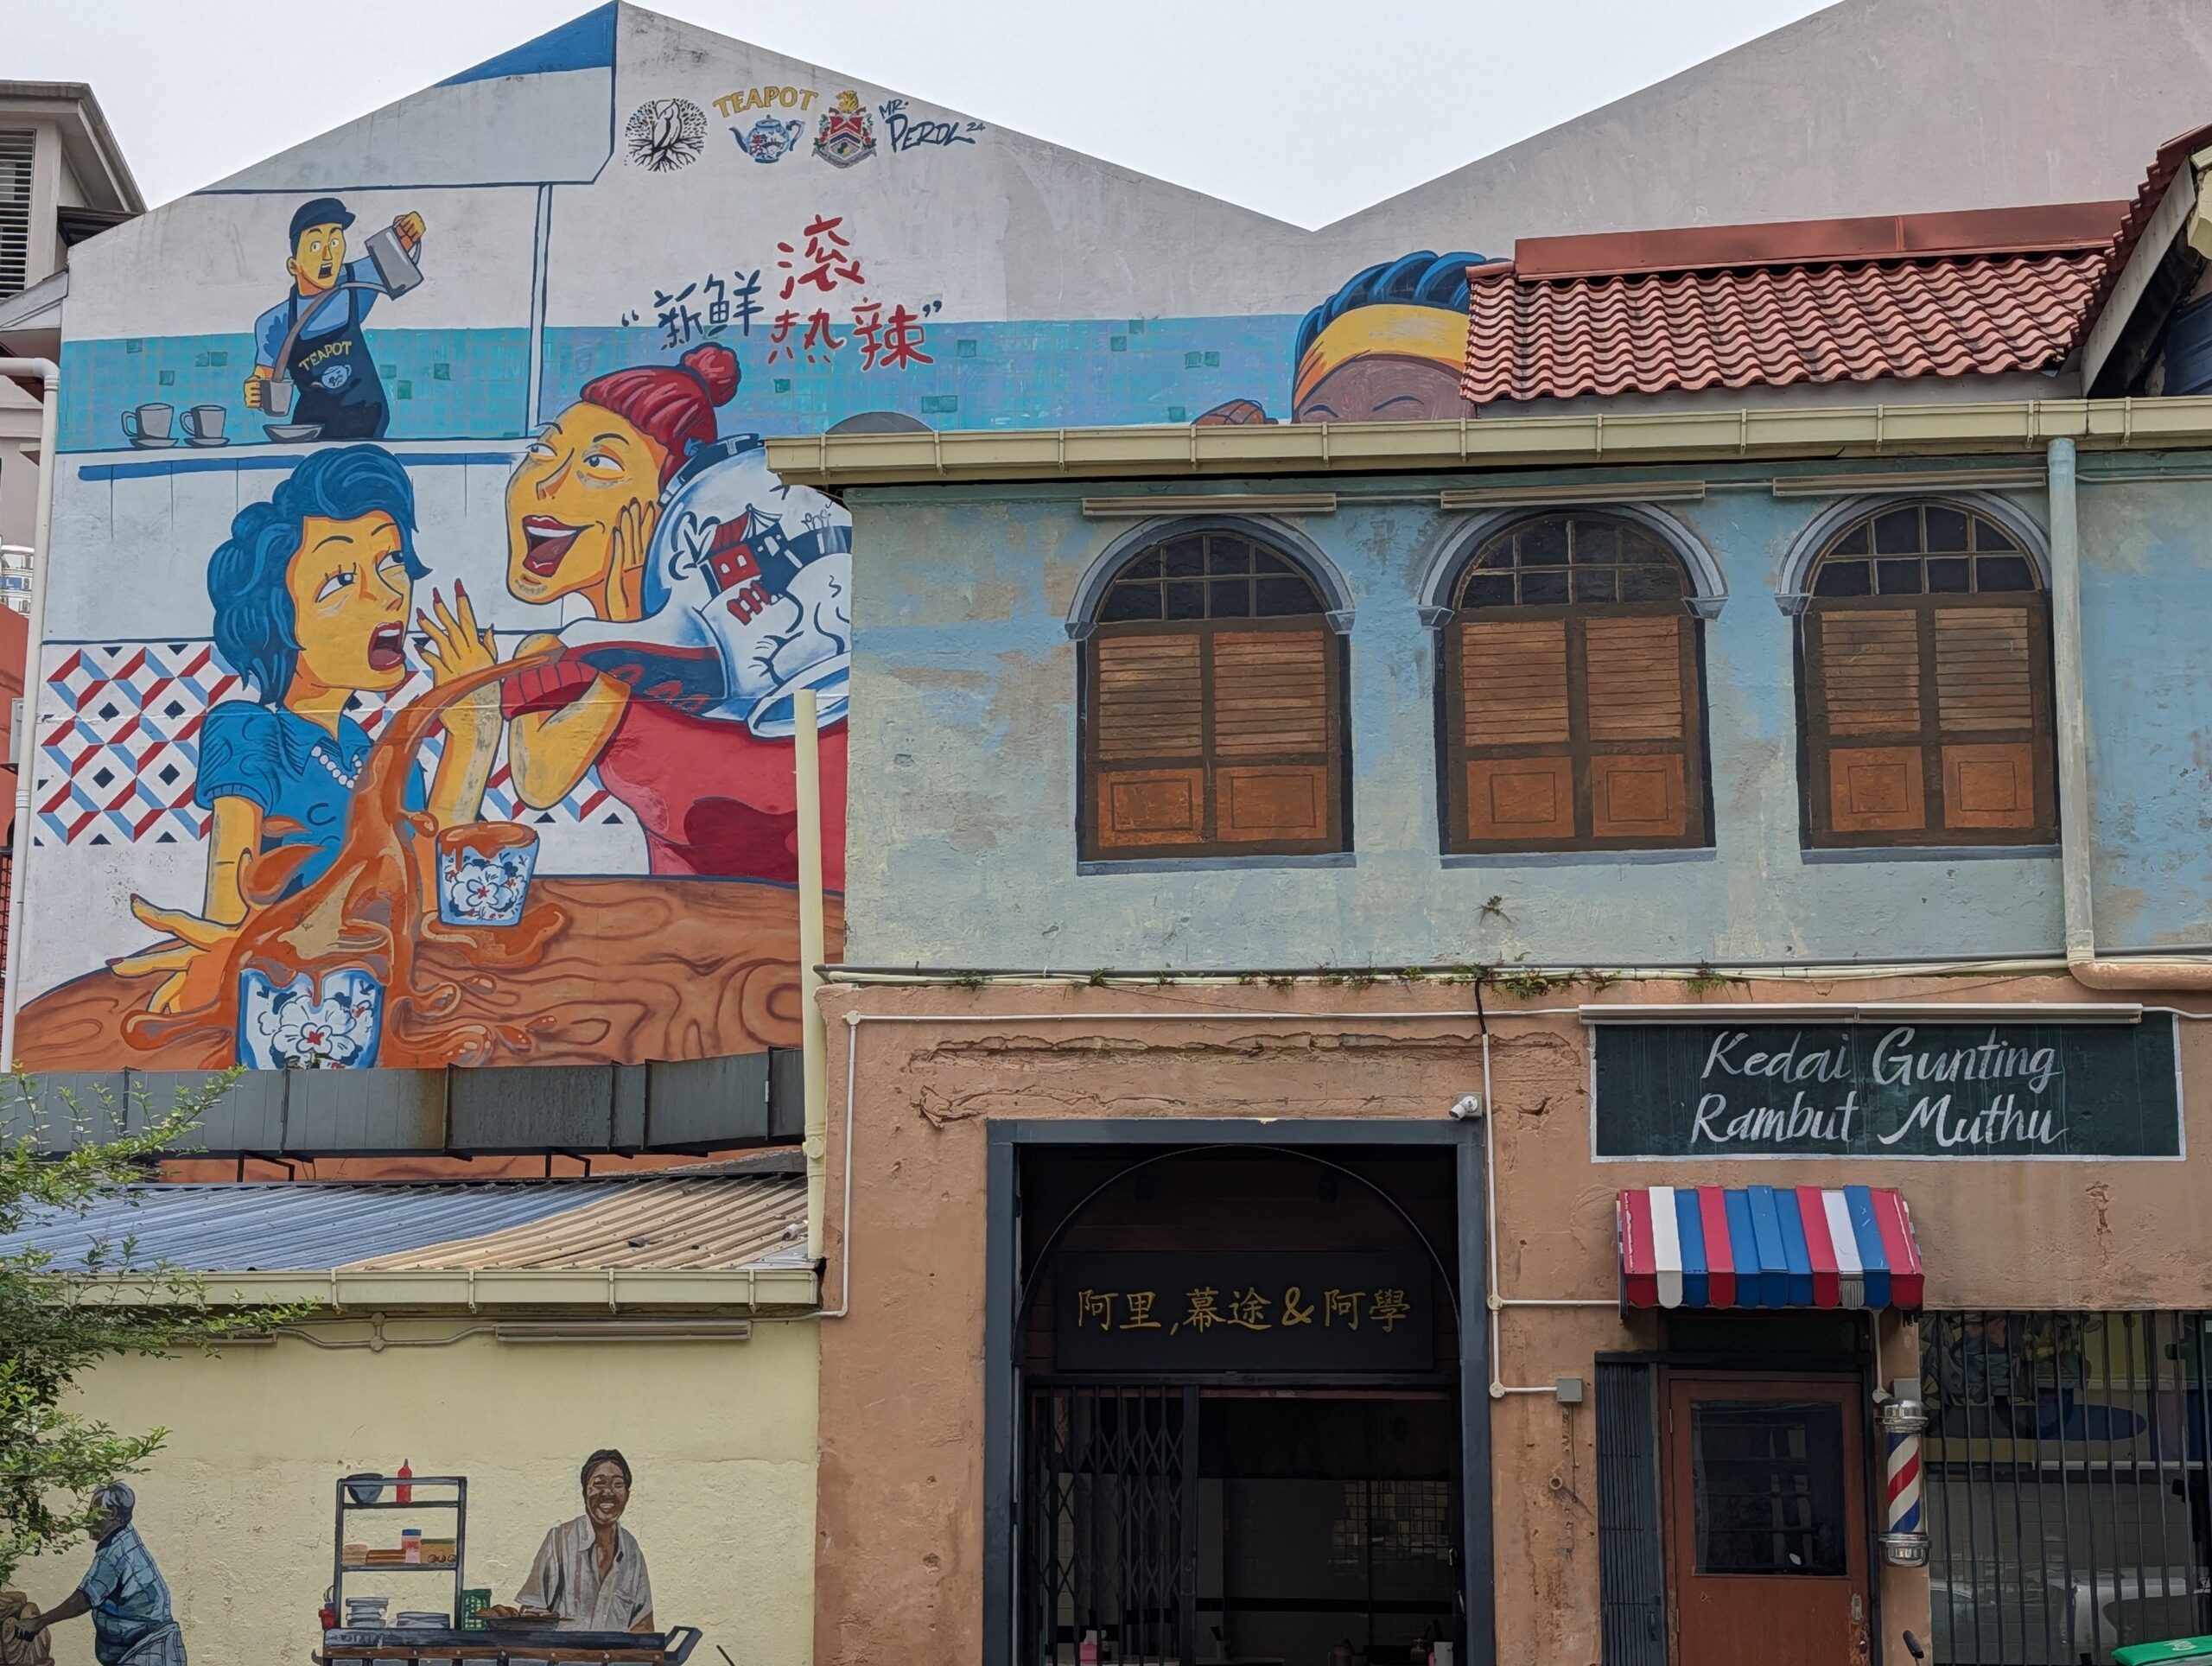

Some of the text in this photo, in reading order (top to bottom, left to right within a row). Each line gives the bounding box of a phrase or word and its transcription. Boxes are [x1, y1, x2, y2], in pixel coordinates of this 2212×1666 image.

[713, 86, 818, 118] TEAPOT
[299, 341, 352, 371] TEAPOT
[1700, 1027, 2063, 1094] Kedai Gunting
[1690, 1091, 2070, 1147] Rambut Muthu
